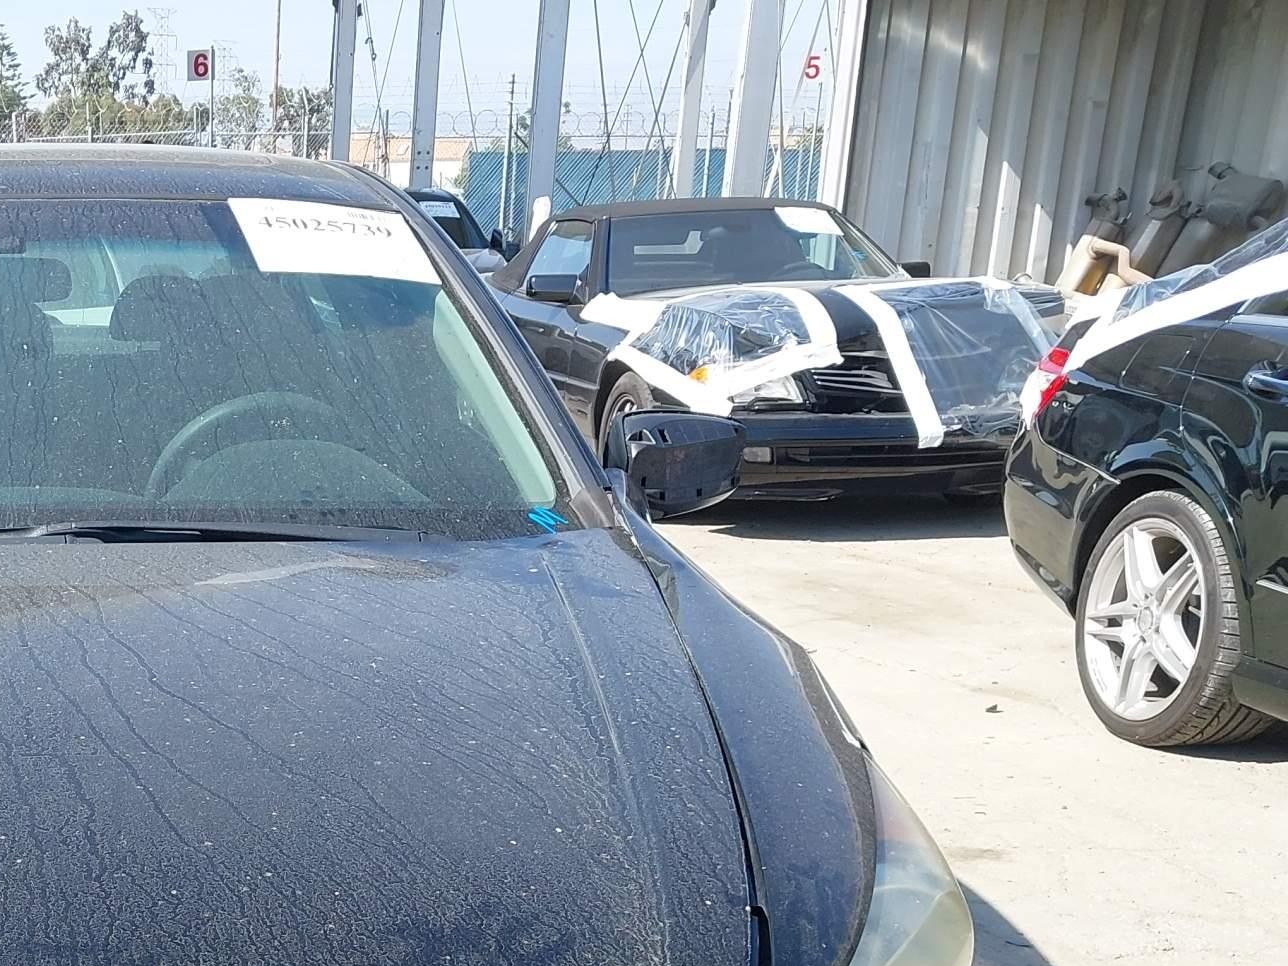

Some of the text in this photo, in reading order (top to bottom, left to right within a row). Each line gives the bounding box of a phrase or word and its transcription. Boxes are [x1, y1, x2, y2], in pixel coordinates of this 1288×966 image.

[194, 53, 208, 77] 6
[805, 56, 820, 79] 5
[258, 216, 393, 238] 45025739
